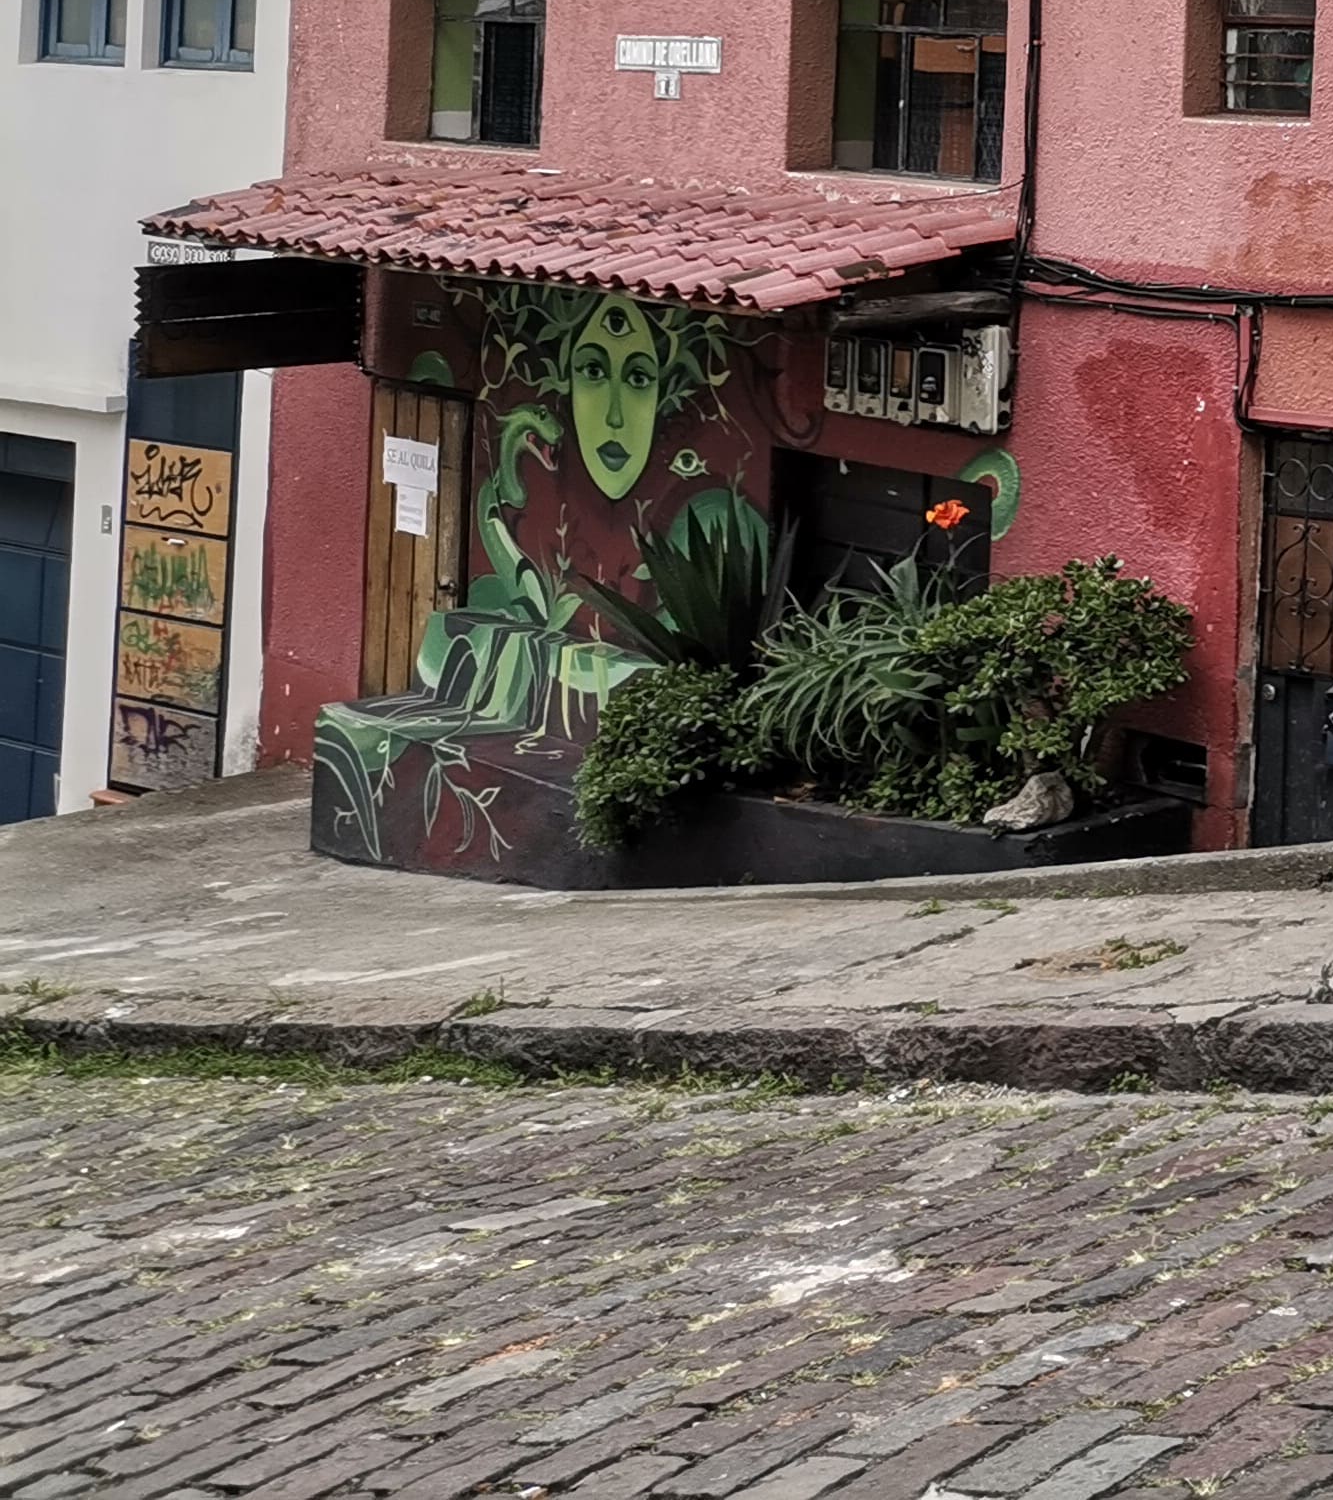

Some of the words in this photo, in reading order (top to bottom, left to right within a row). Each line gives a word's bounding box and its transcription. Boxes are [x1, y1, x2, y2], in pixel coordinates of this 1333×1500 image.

[619, 40, 653, 65] CAMINO
[655, 41, 667, 66] DE
[668, 41, 718, 68] ORELLANA
[150, 244, 179, 263] CASA
[184, 247, 204, 263] DEL
